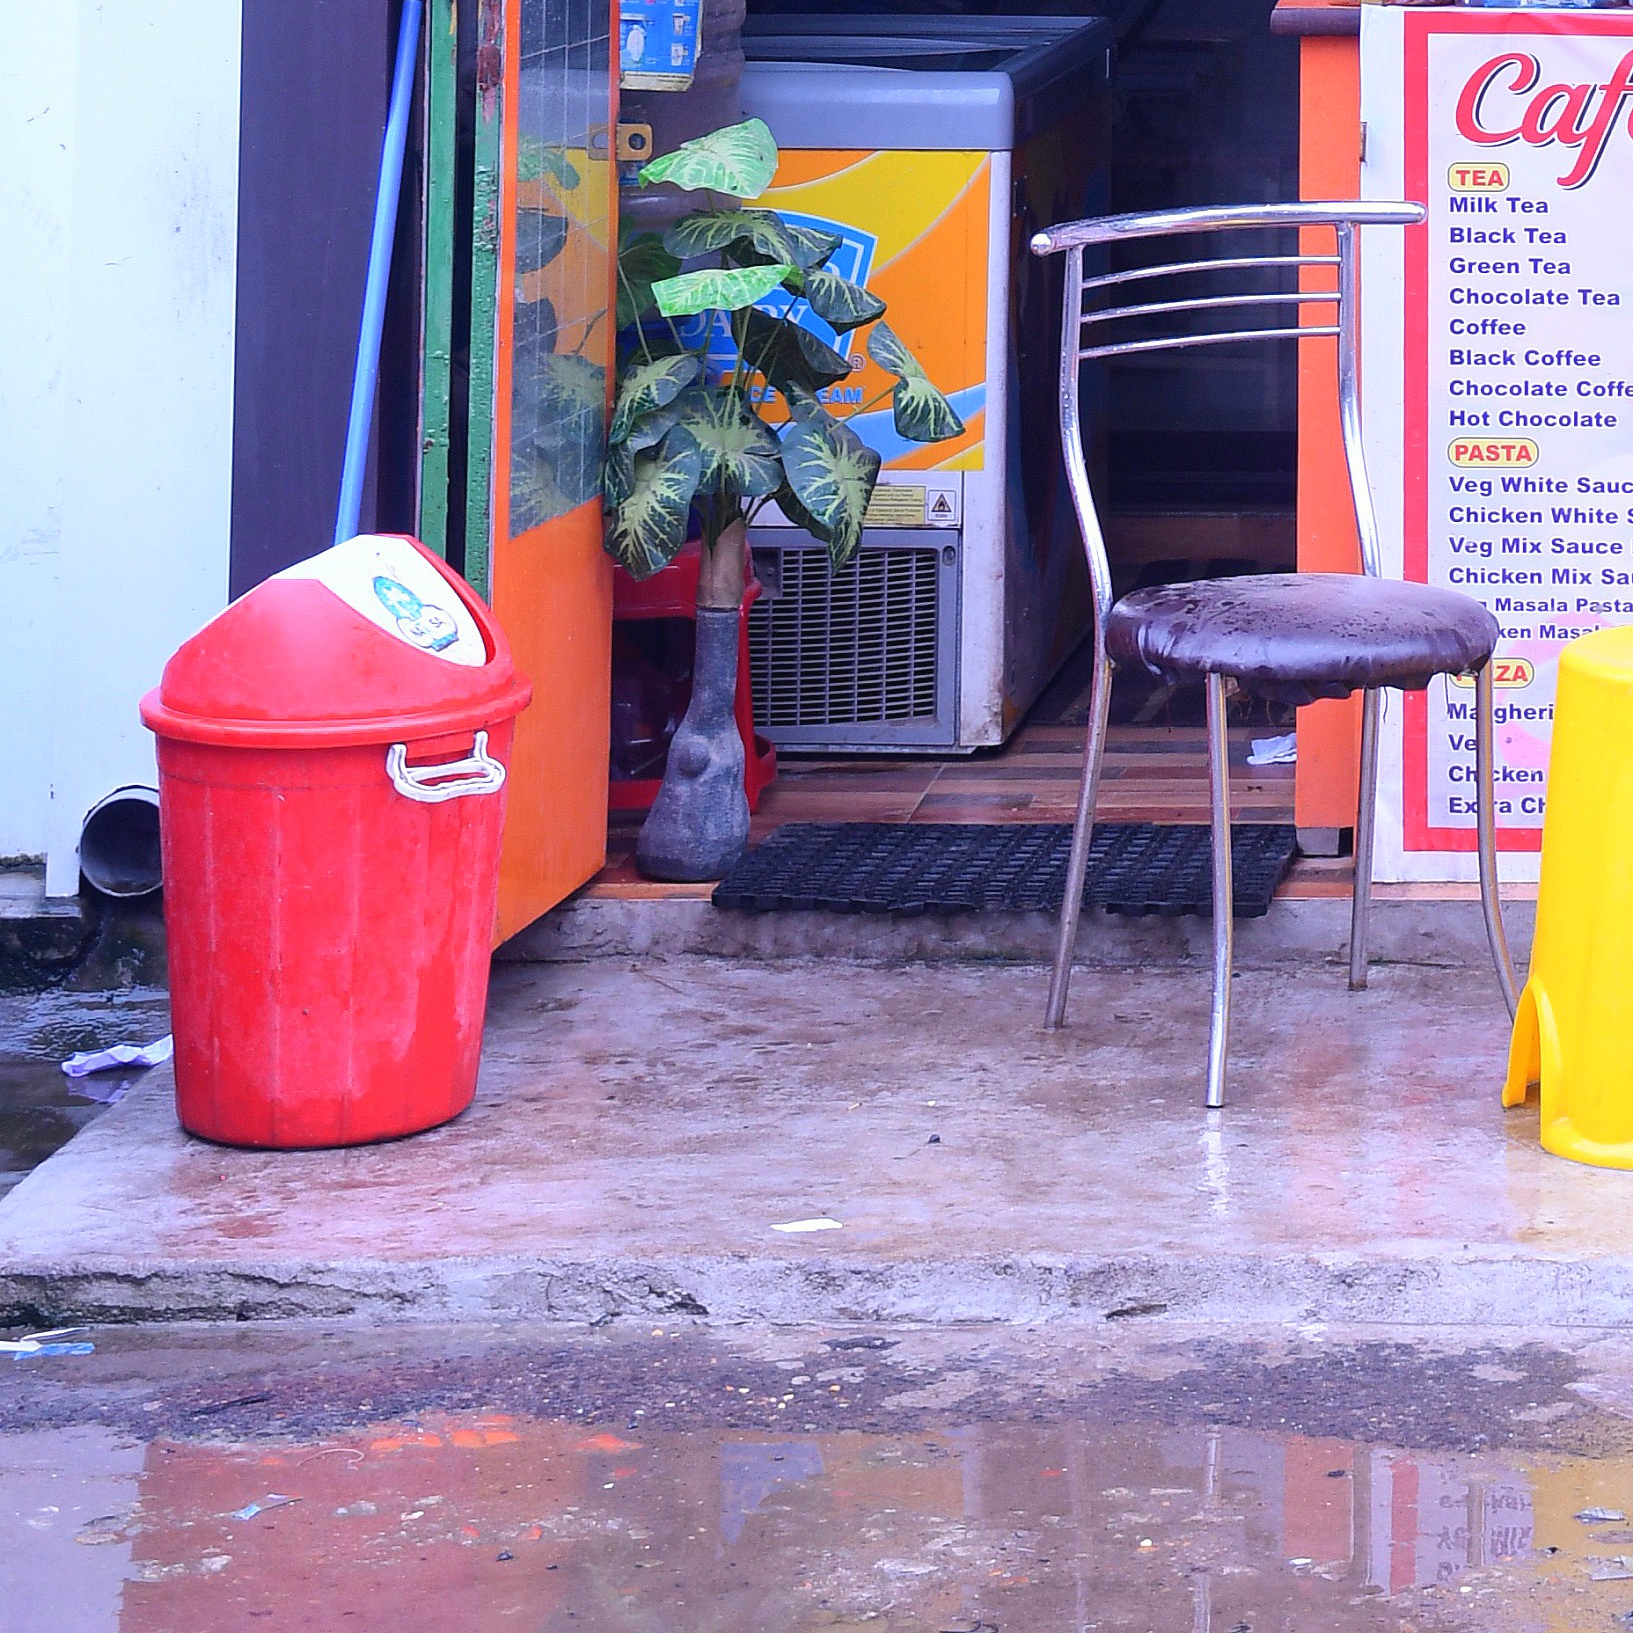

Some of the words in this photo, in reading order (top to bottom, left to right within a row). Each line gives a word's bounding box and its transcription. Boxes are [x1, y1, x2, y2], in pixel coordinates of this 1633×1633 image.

[1455, 170, 1504, 187] TEA
[1449, 196, 1500, 213] Milk
[1505, 197, 1549, 214] Tea
[1450, 227, 1516, 244] Black
[1523, 227, 1567, 244] Tea
[1449, 257, 1520, 274] Green
[1528, 258, 1571, 275] Tea
[1449, 287, 1569, 305] Chocolate
[1577, 288, 1620, 306] Tea
[1449, 318, 1526, 336] Coffee
[1449, 349, 1516, 366] Black
[1524, 349, 1601, 367] Coffee
[1449, 379, 1568, 397] Chocolate
[1449, 410, 1490, 427] Hot
[1498, 410, 1617, 428] Chocolate
[1455, 444, 1532, 462] PASTA
[1448, 476, 1492, 497] Veg
[1500, 476, 1569, 493] White
